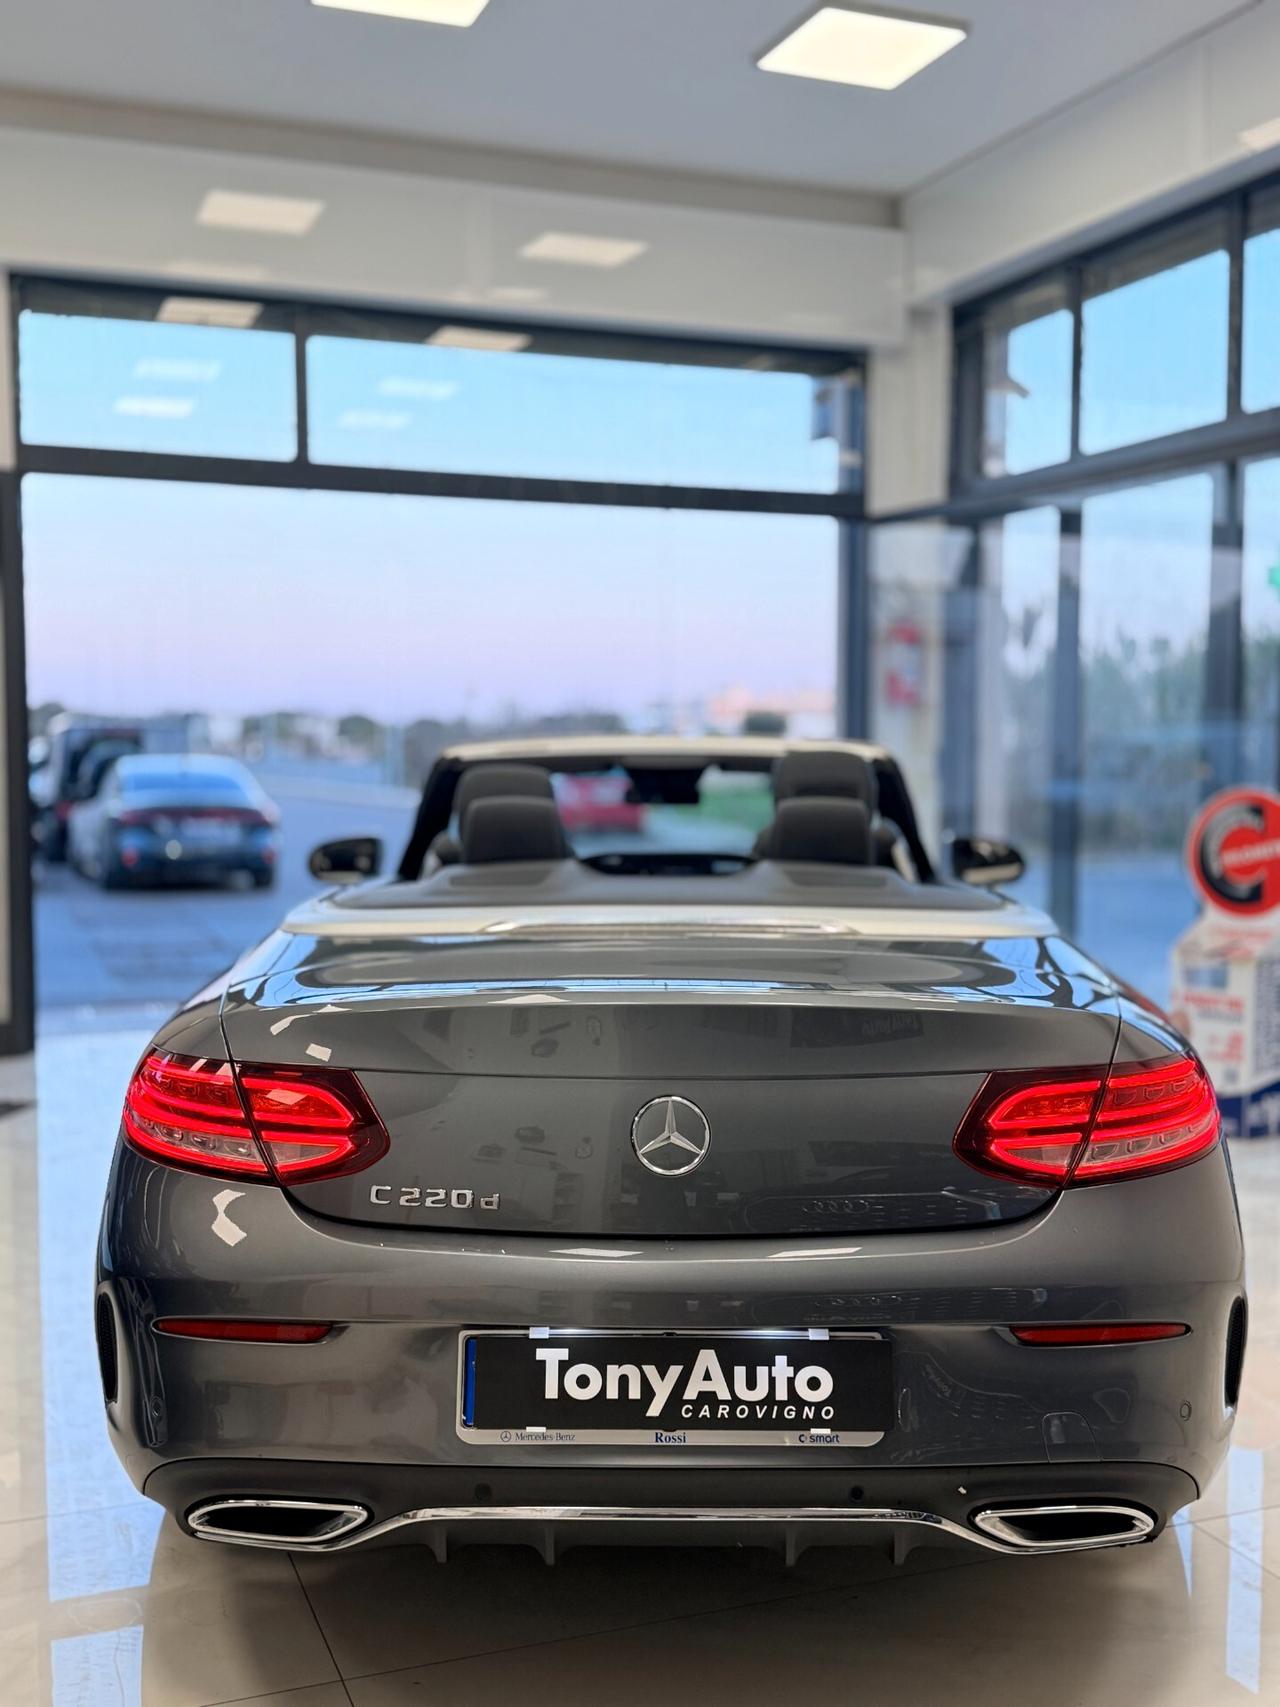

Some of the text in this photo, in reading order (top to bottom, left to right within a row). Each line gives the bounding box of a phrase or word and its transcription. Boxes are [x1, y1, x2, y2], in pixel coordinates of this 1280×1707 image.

[369, 1184, 500, 1210] C 220 d
[535, 1347, 835, 1418] TonyAuto
[681, 1404, 835, 1420] CAROVIGNO
[654, 1431, 687, 1444] Rossi
[809, 1433, 840, 1444] smart
